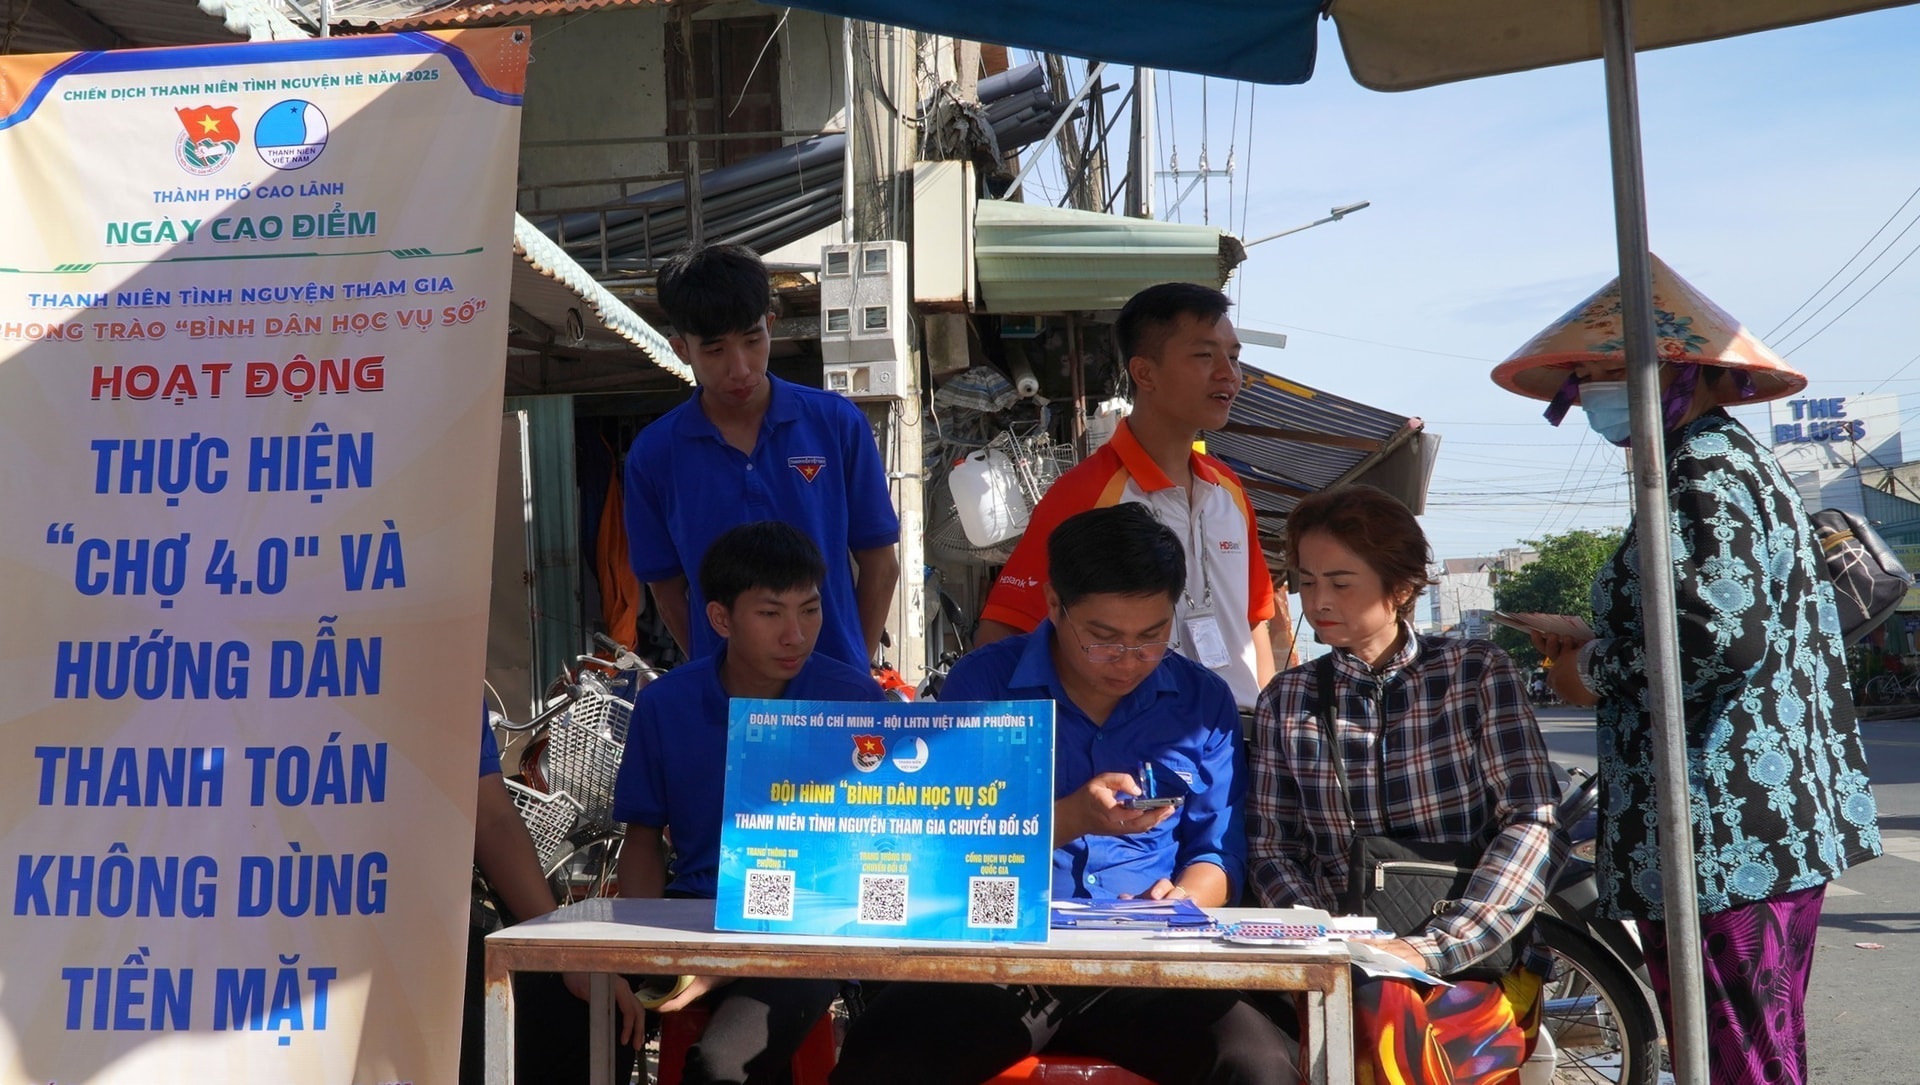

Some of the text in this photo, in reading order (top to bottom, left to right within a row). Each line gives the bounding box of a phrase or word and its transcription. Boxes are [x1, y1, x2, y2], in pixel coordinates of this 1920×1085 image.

[64, 69, 439, 101] CHIẾN DỊCH THANH NIÊN TÌNH NGUYỆN HÈ NĂM 2025
[153, 181, 344, 203] THÀNH PHỐ CAO LÃNH
[106, 202, 377, 246] NGÀY CAO ĐIỂM
[28, 277, 454, 307] THANH NIÊN TÌNH NGUYỆN THAM GIA
[0, 321, 84, 340] HONG
[93, 317, 166, 339] TRÀO
[175, 316, 256, 337] “BÌNH
[265, 313, 322, 335] DÂN
[332, 311, 388, 335] HỌC
[396, 309, 433, 331] VỤ
[91, 354, 386, 404] HOẠT ĐỘNG
[1788, 397, 1847, 420] THE
[1774, 419, 1866, 445] BLUES
[90, 422, 374, 507] THỰC HIỆN
[46, 522, 190, 608] “CHỢ
[340, 520, 406, 592] VÀ
[53, 615, 382, 700] HƯỚNG DẪN
[749, 712, 778, 725] ĐOÀN
[781, 715, 807, 726] TNCS
[810, 713, 824, 727] HỒ
[826, 714, 844, 727] CHÍ
[847, 716, 874, 728] MINH
[884, 715, 901, 730] HỘI
[904, 716, 929, 728] LHTN
[932, 715, 954, 730] VIỆT
[956, 716, 980, 728] NAM
[983, 713, 1025, 728] PHƯỜNG
[1028, 715, 1034, 727] 1
[34, 731, 388, 807] THANH TOÁN
[771, 780, 796, 806] ĐỘI
[800, 781, 835, 804] HÌNH
[840, 779, 883, 805] “BÌNH
[886, 782, 917, 806] DÂN
[921, 786, 951, 810] HỌC
[955, 786, 974, 810] VỤ
[735, 812, 1040, 836] THANH NIÊN TÌNH NGUYỆN THAM GIA CHUYỂN ĐỔI SỐ
[13, 842, 388, 918] KHÔNG DÙNG
[61, 946, 337, 1046] TIỀN MẶT
